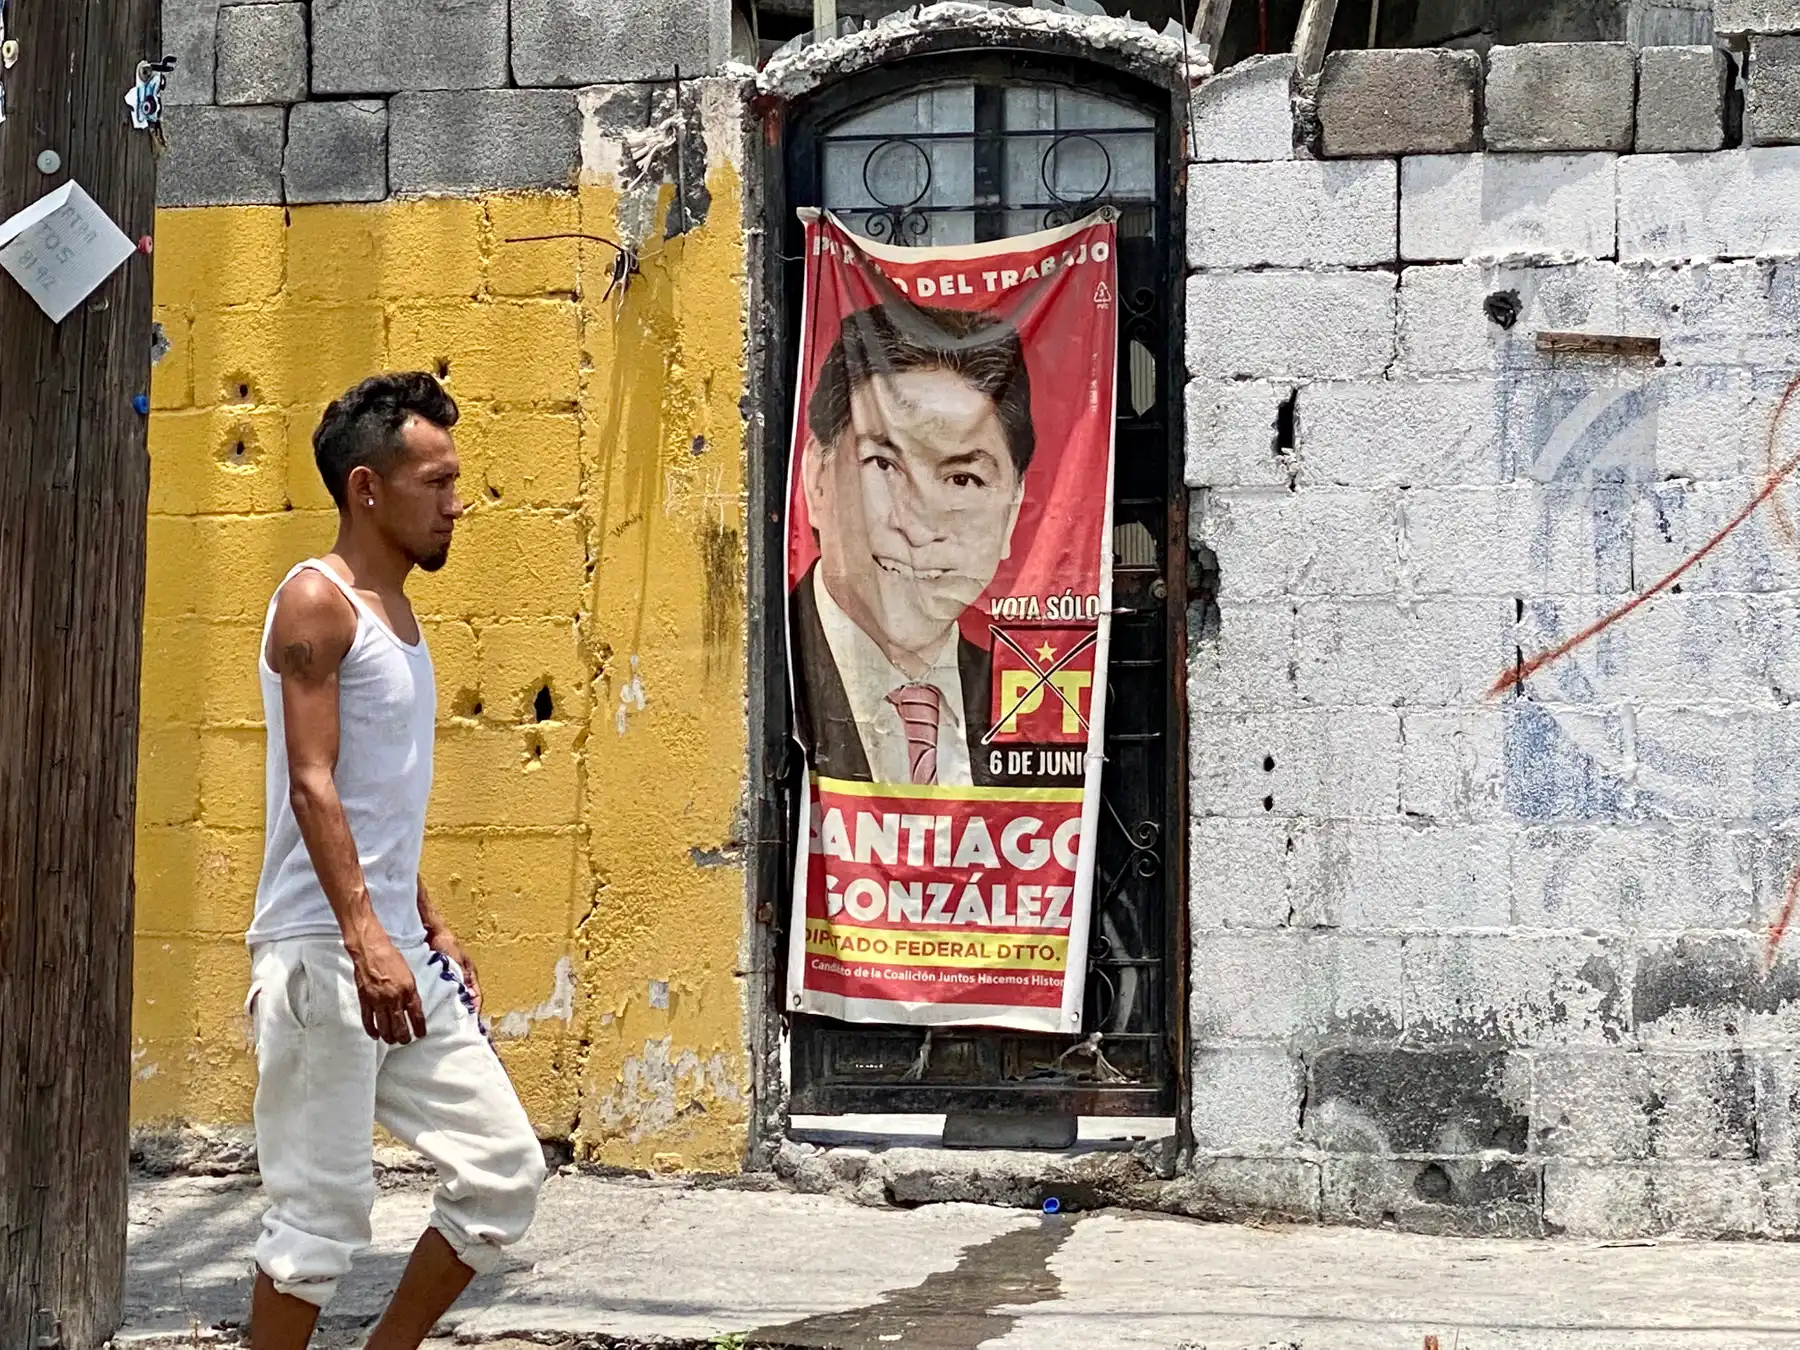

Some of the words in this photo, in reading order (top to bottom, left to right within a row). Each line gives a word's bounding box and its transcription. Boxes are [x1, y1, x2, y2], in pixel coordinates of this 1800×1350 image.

[917, 274, 973, 298] DEL
[991, 597, 1040, 621] VOTA
[1047, 589, 1100, 621] SÓLO
[999, 670, 1092, 734] PT
[990, 750, 1003, 775] 6
[1008, 750, 1033, 776] DE
[895, 940, 992, 959] FEDERAL
[997, 944, 1061, 962] DTTO.
[853, 966, 870, 978] de
[871, 967, 881, 979] la
[883, 968, 936, 983] Coalición
[937, 971, 975, 984] Juntos
[978, 973, 1029, 986] Hacemos
